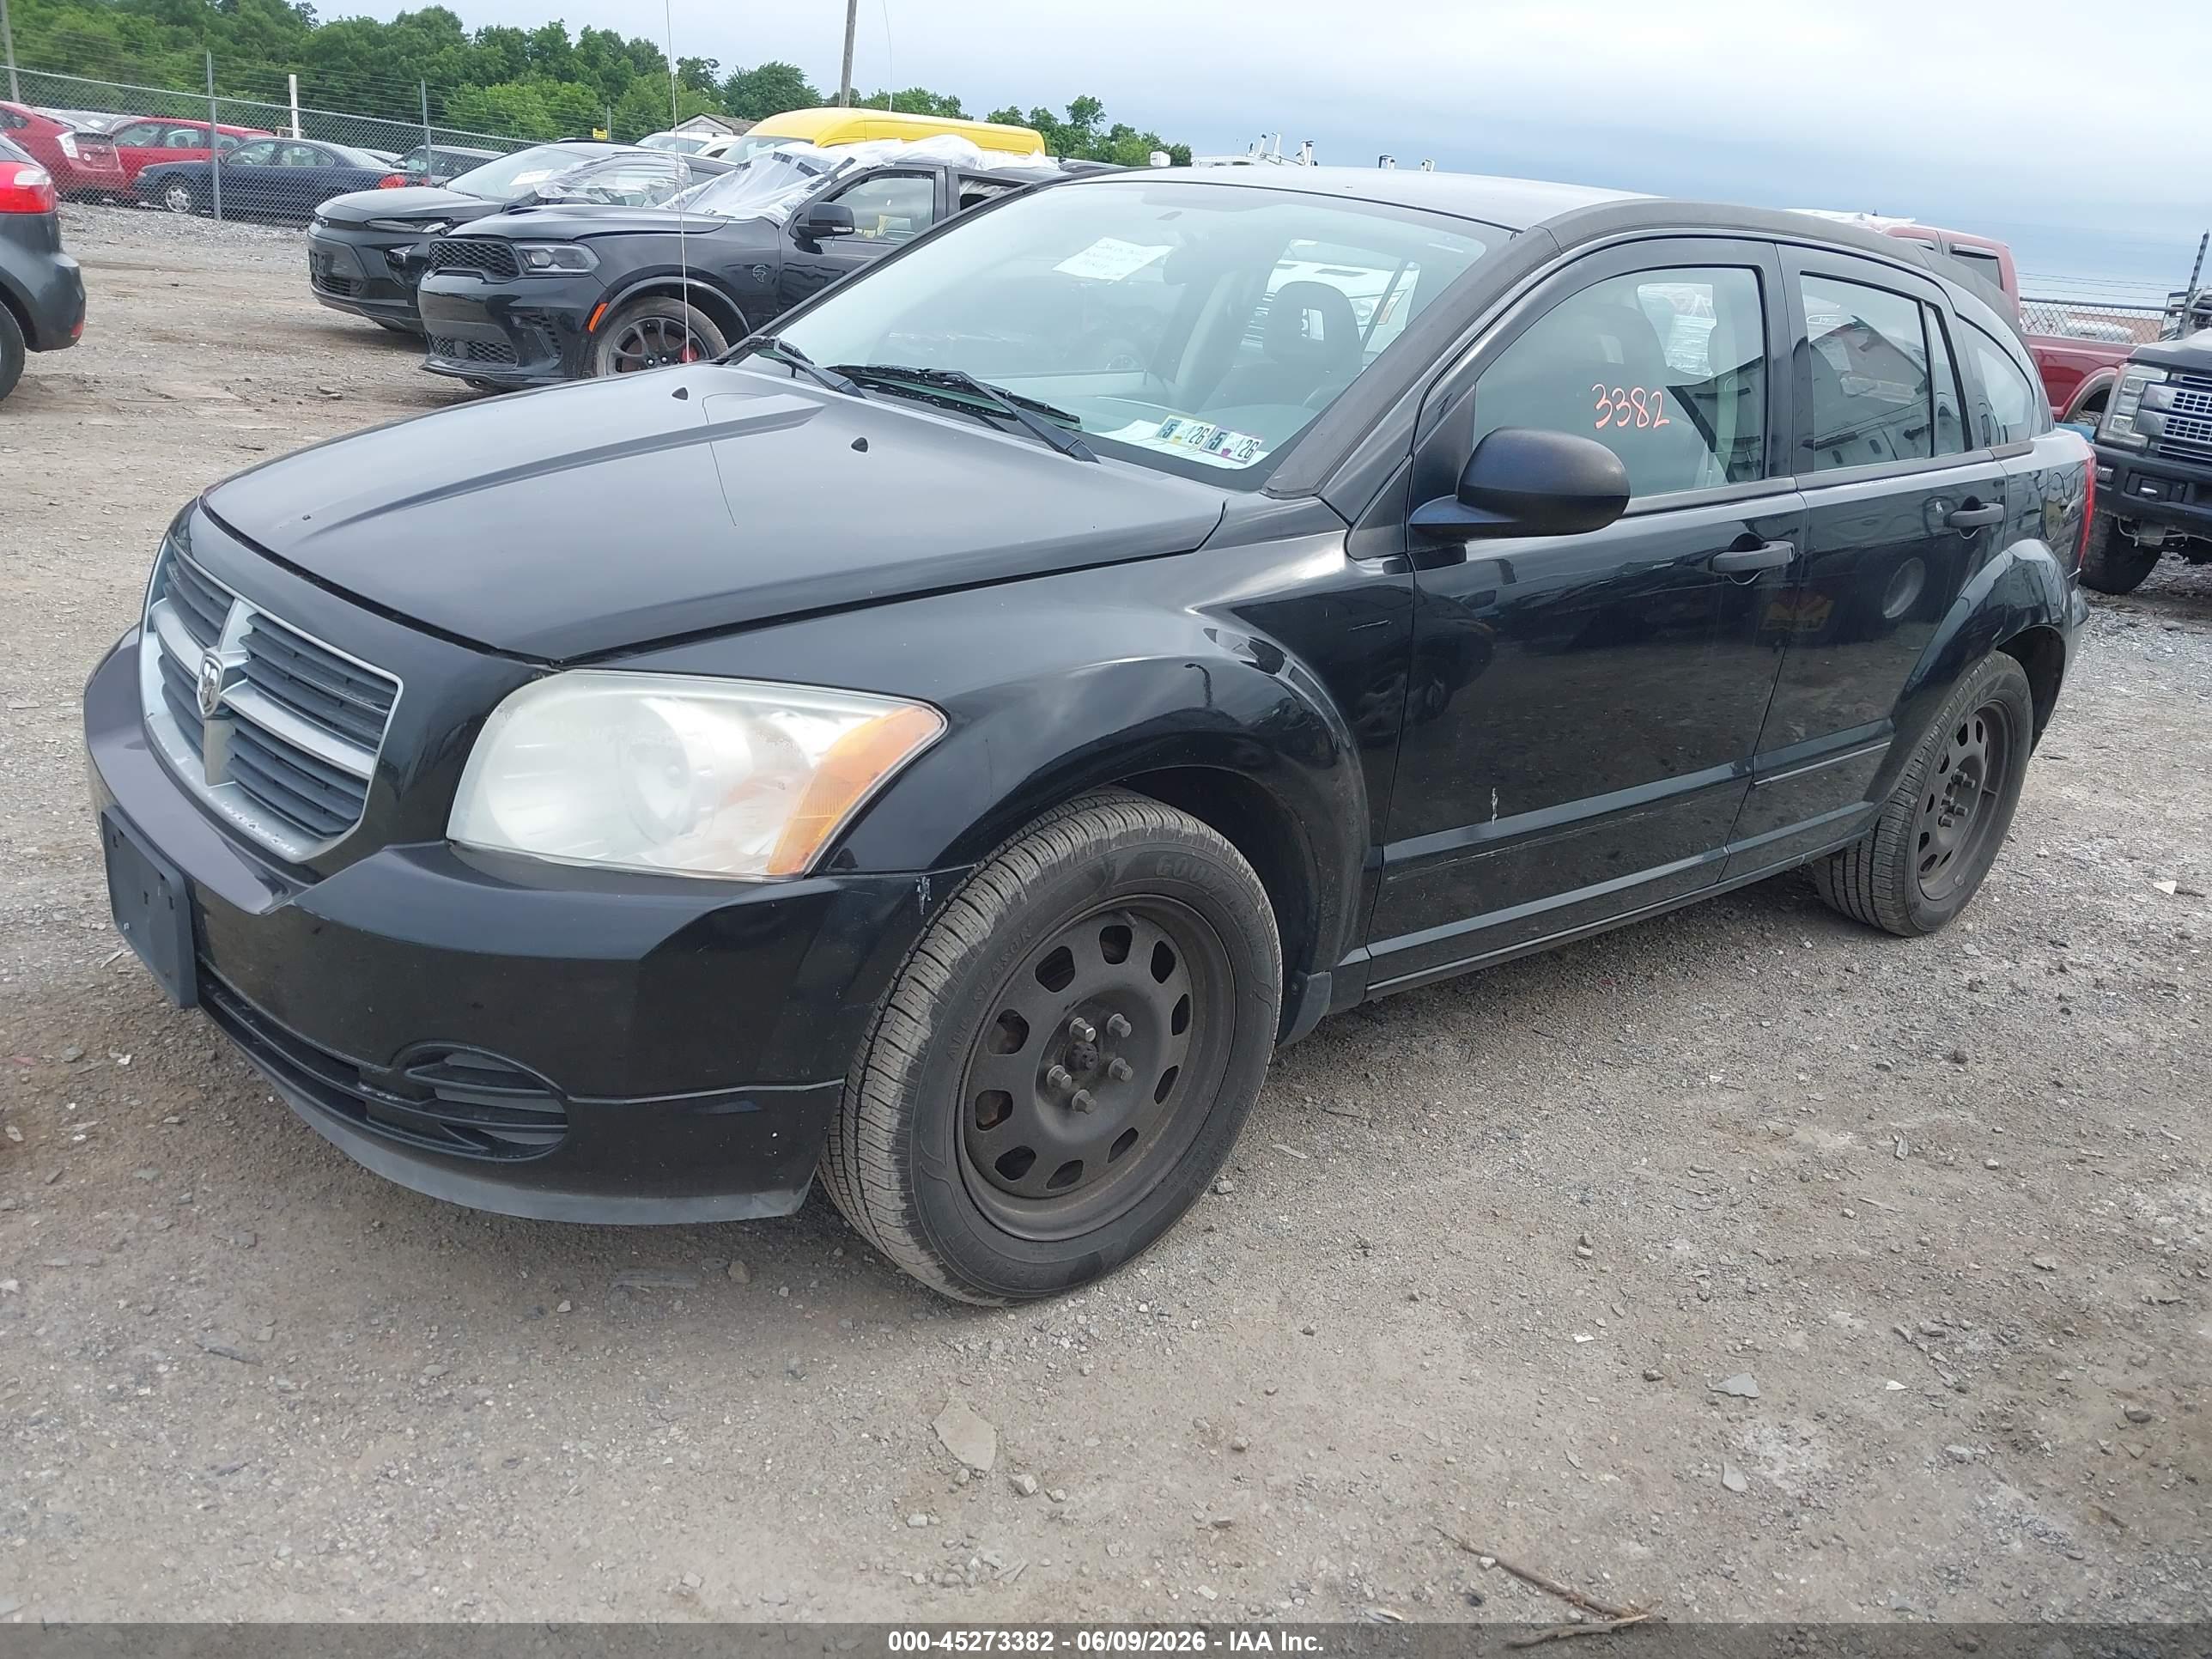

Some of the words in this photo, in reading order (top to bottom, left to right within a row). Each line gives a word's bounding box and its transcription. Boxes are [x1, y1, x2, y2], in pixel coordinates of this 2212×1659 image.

[1591, 383, 1670, 429] 3382
[1163, 423, 1177, 439] 5
[1188, 426, 1210, 445] 26
[1208, 431, 1227, 451] 5
[1237, 439, 1261, 459] 26
